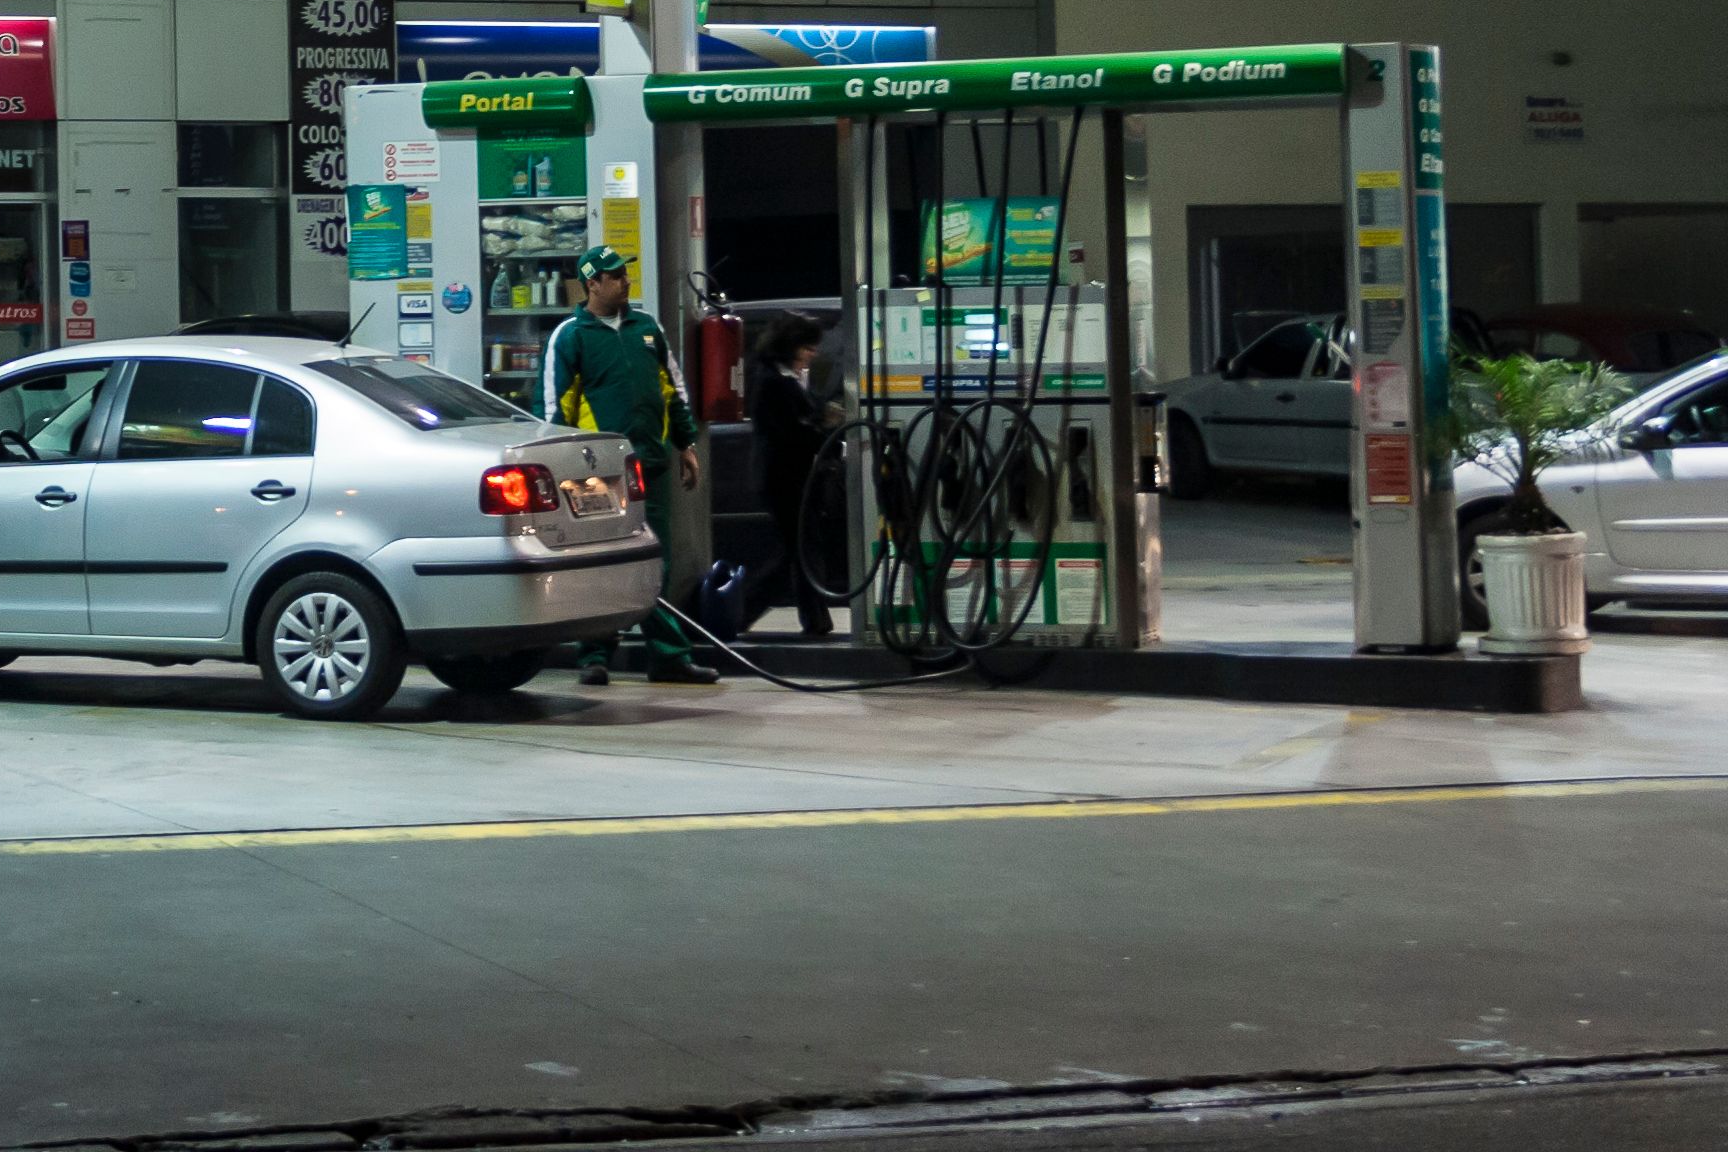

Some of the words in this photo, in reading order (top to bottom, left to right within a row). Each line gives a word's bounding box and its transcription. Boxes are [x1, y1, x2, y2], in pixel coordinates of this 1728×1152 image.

[317, 1, 381, 32] 45,00
[297, 47, 390, 69] PROGRESSIVA
[1011, 68, 1105, 92] Etanol
[1153, 62, 1173, 84] G
[1182, 59, 1286, 83] Podium
[1368, 60, 1385, 82] 2
[689, 85, 707, 104] G
[715, 83, 812, 104] Comum
[844, 78, 863, 98] G
[873, 76, 950, 99] Supra
[459, 92, 534, 112] Portal
[299, 125, 346, 143] COLO
[406, 300, 427, 308] VISA
